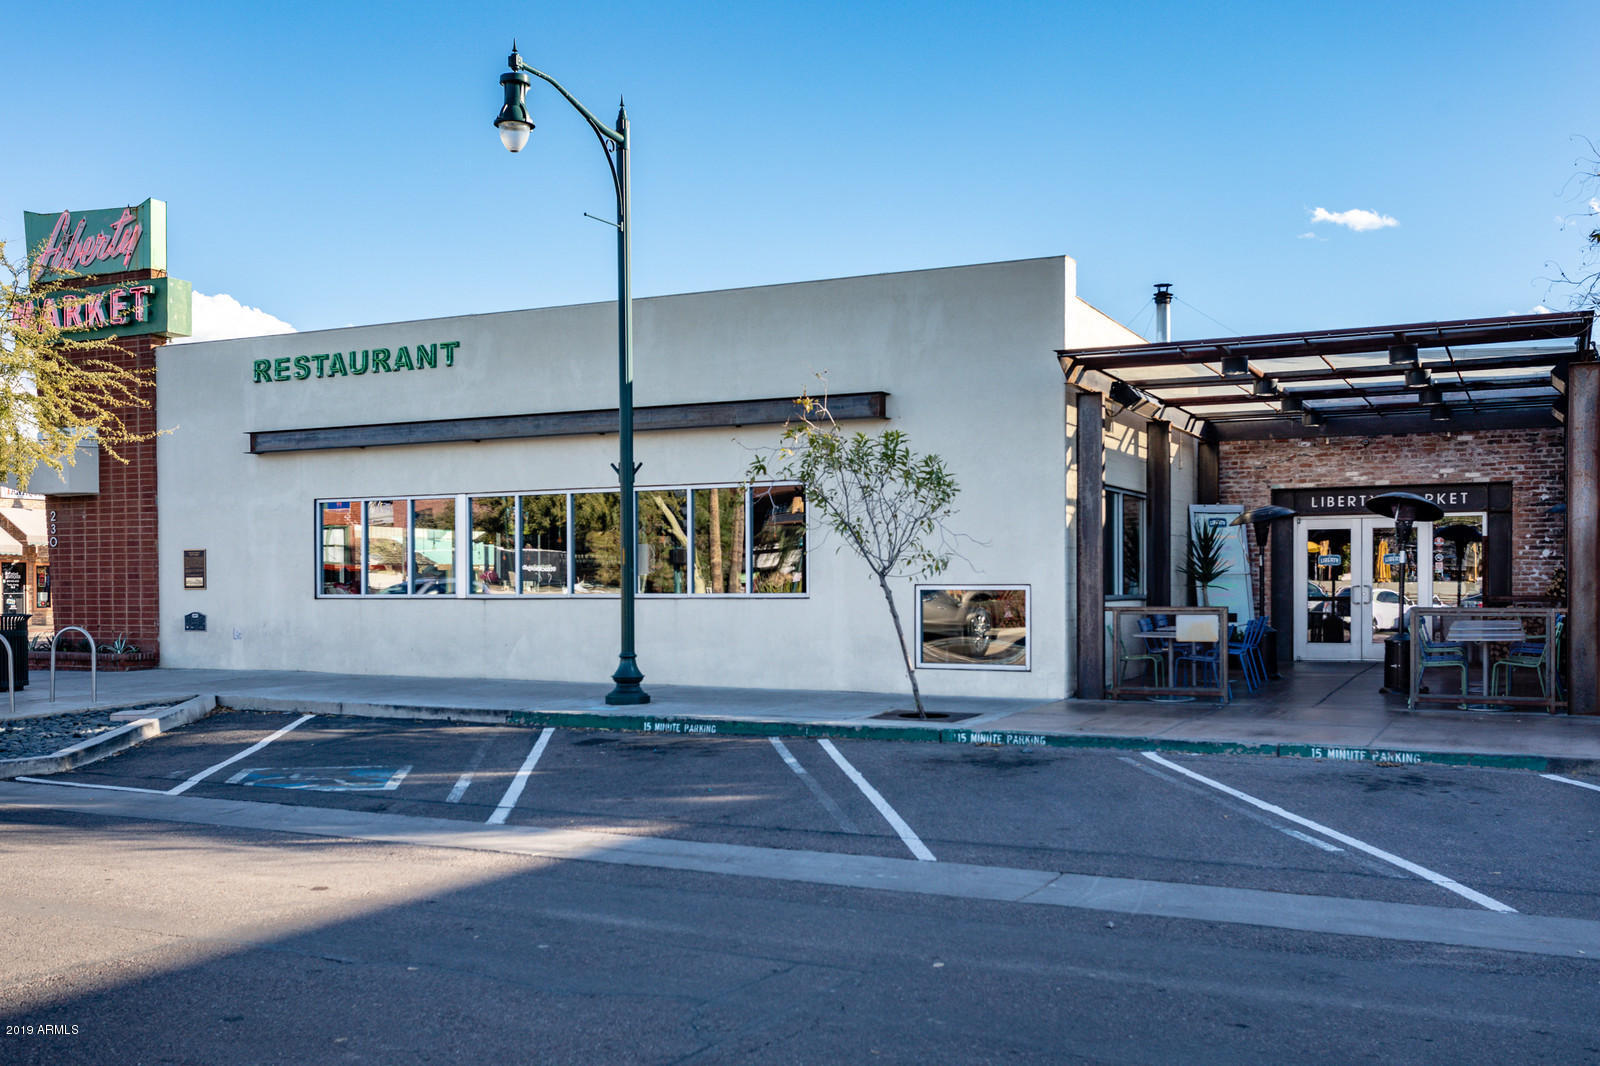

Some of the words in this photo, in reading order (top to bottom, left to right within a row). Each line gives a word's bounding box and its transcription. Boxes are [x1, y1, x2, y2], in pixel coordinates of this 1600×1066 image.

[30, 209, 143, 282] Liberty
[12, 285, 153, 331] MARKET
[253, 341, 461, 383] RESTAURANT
[643, 721, 652, 732] 15
[654, 722, 681, 733] MINUTE
[683, 723, 717, 734] PARKING
[970, 732, 1002, 745] MINUTE
[1006, 734, 1047, 745] PARKING
[1311, 747, 1323, 759] 15
[1327, 749, 1367, 761] MINUTE
[1372, 750, 1421, 764] PARKING
